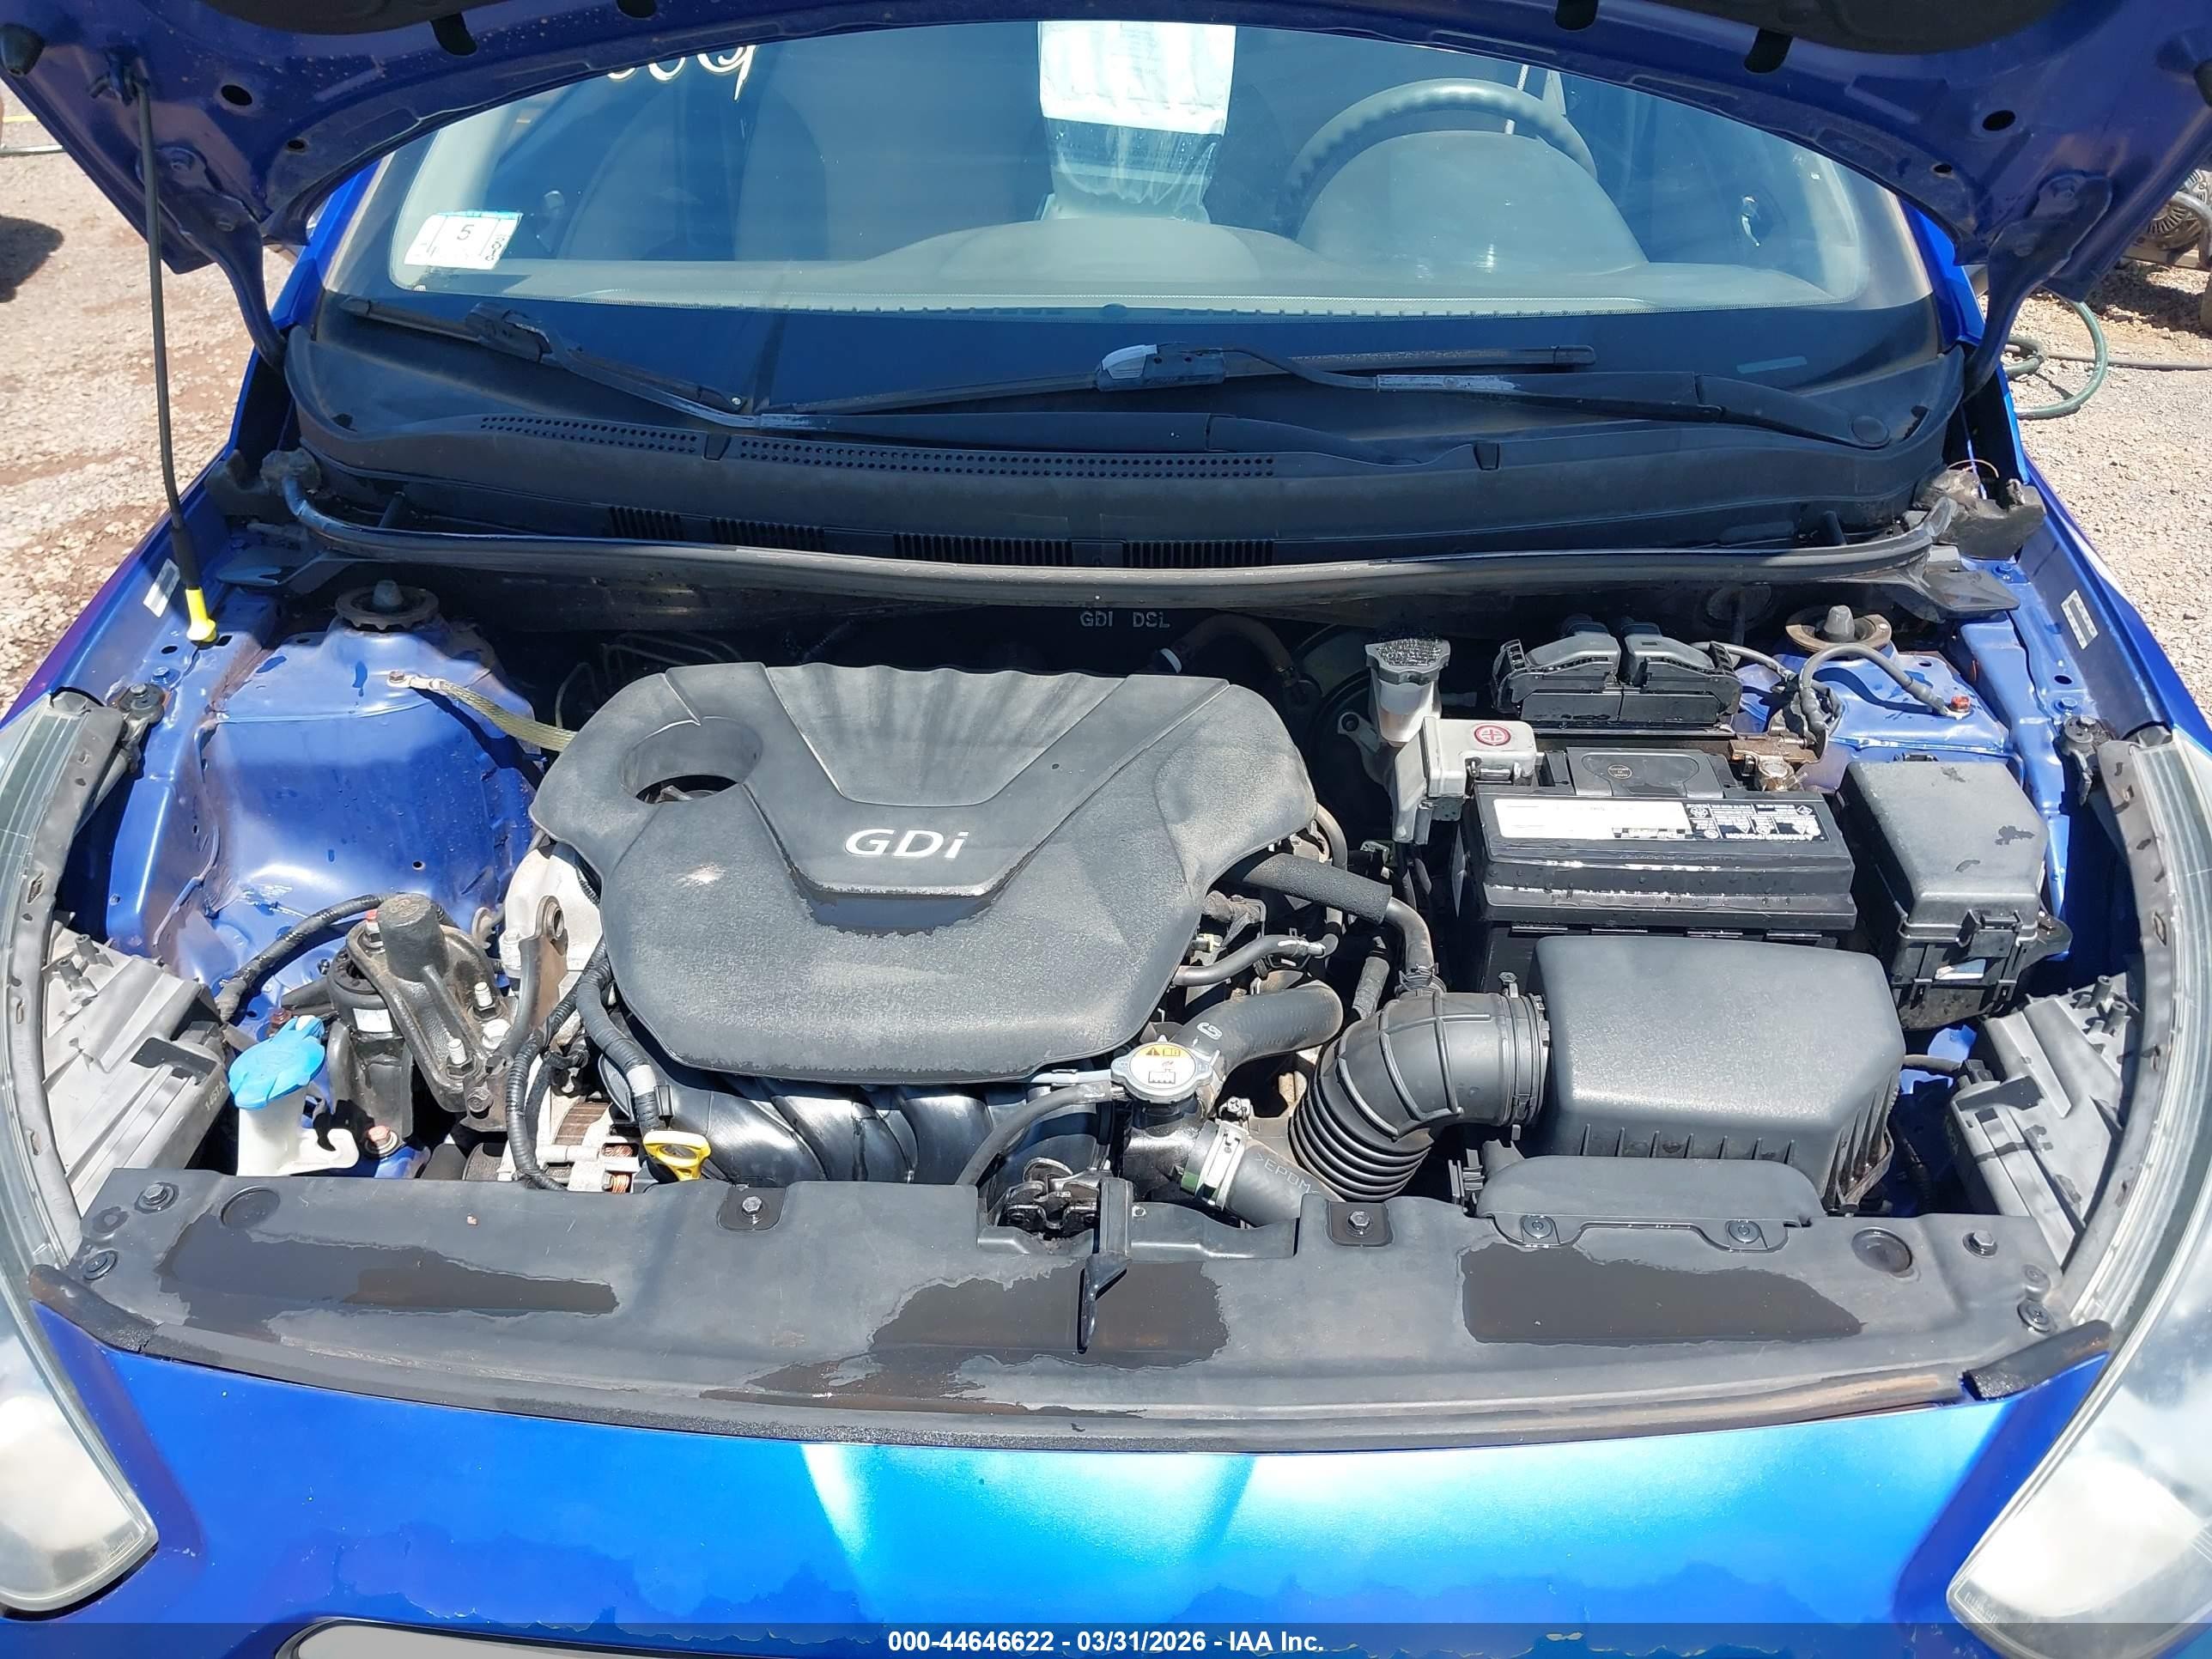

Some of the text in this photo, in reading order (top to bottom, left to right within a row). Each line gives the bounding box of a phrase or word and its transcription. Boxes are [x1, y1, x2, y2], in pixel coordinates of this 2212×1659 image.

[457, 224, 475, 240] 5
[1080, 611, 1113, 627] GDI
[845, 829, 969, 859] GDi
